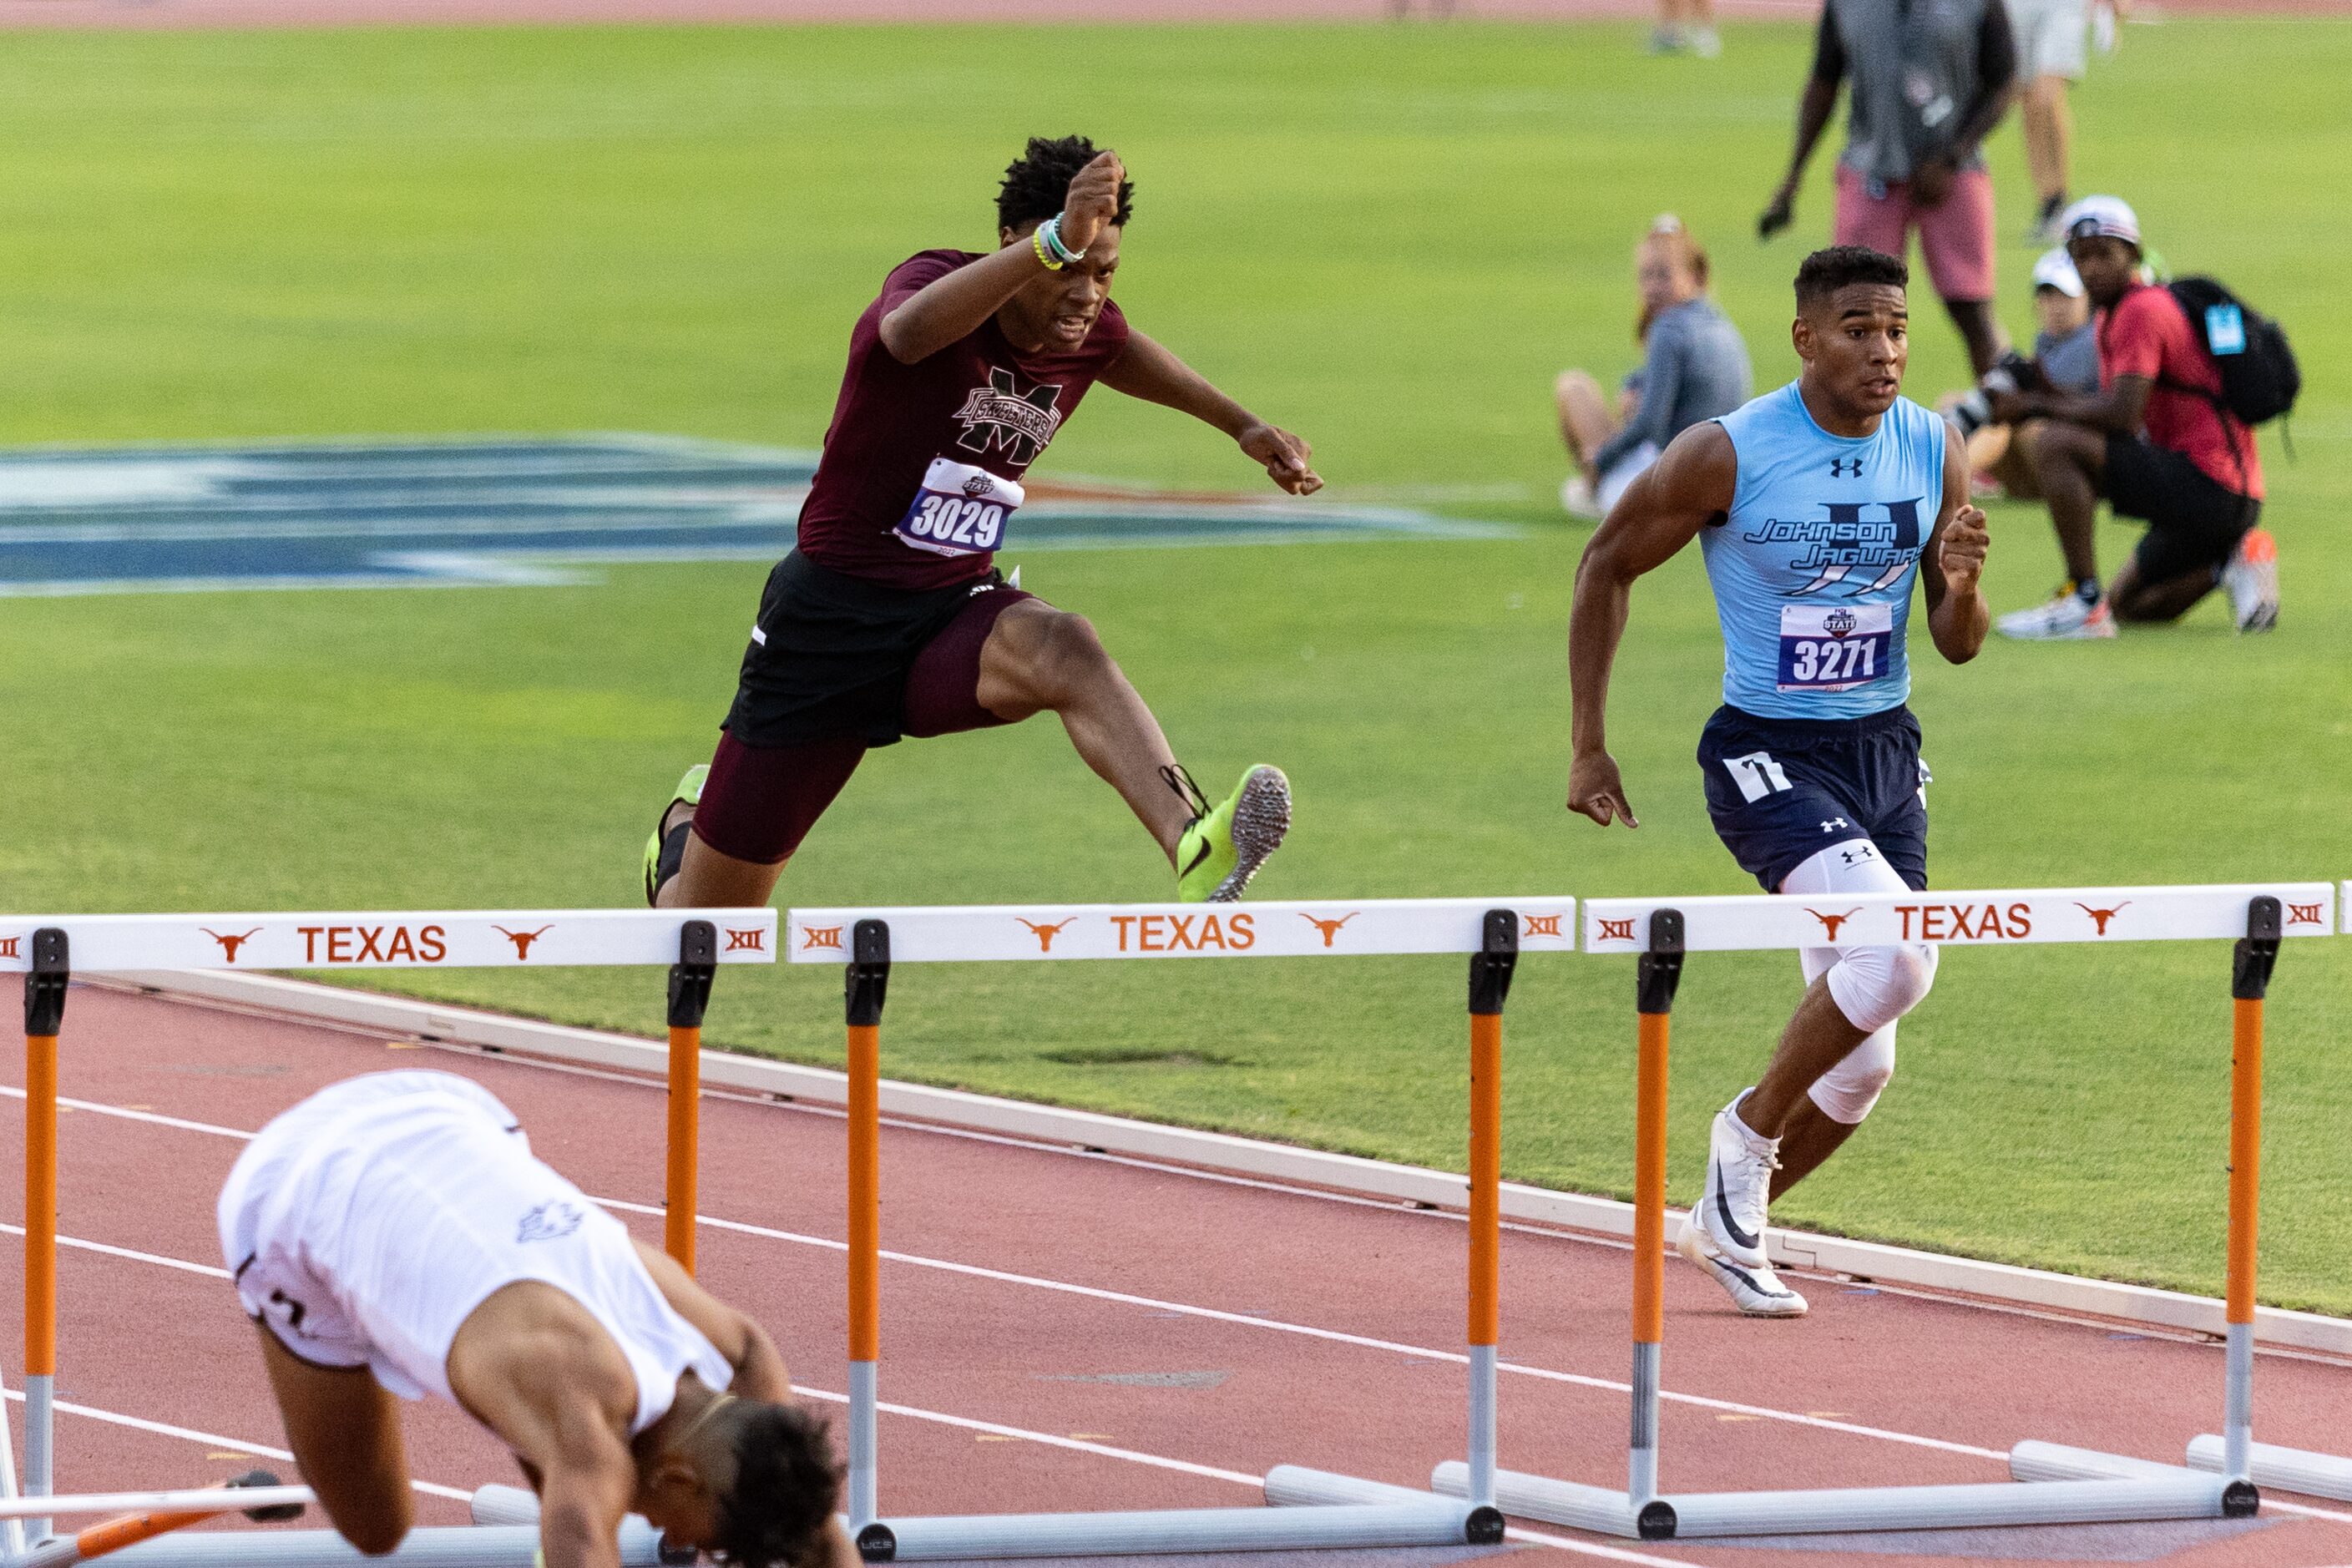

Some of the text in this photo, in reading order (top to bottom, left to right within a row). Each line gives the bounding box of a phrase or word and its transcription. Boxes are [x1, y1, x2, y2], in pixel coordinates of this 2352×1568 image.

[974, 400, 1050, 441] SKEETERS
[964, 481, 994, 494] STATE
[910, 495, 1004, 548] 3029
[1823, 620, 1856, 630] STATE
[1793, 637, 1877, 681] 3271
[1524, 914, 1563, 937] XII
[1894, 903, 2031, 941] TEXAS
[2287, 903, 2324, 925] XII
[725, 928, 766, 952] XII
[803, 925, 844, 949] XII
[1110, 913, 1256, 952] TEXAS
[1598, 918, 1636, 941] XII
[0, 936, 22, 959] II
[297, 925, 447, 963] TEXAS
[861, 1540, 893, 1550] UCS
